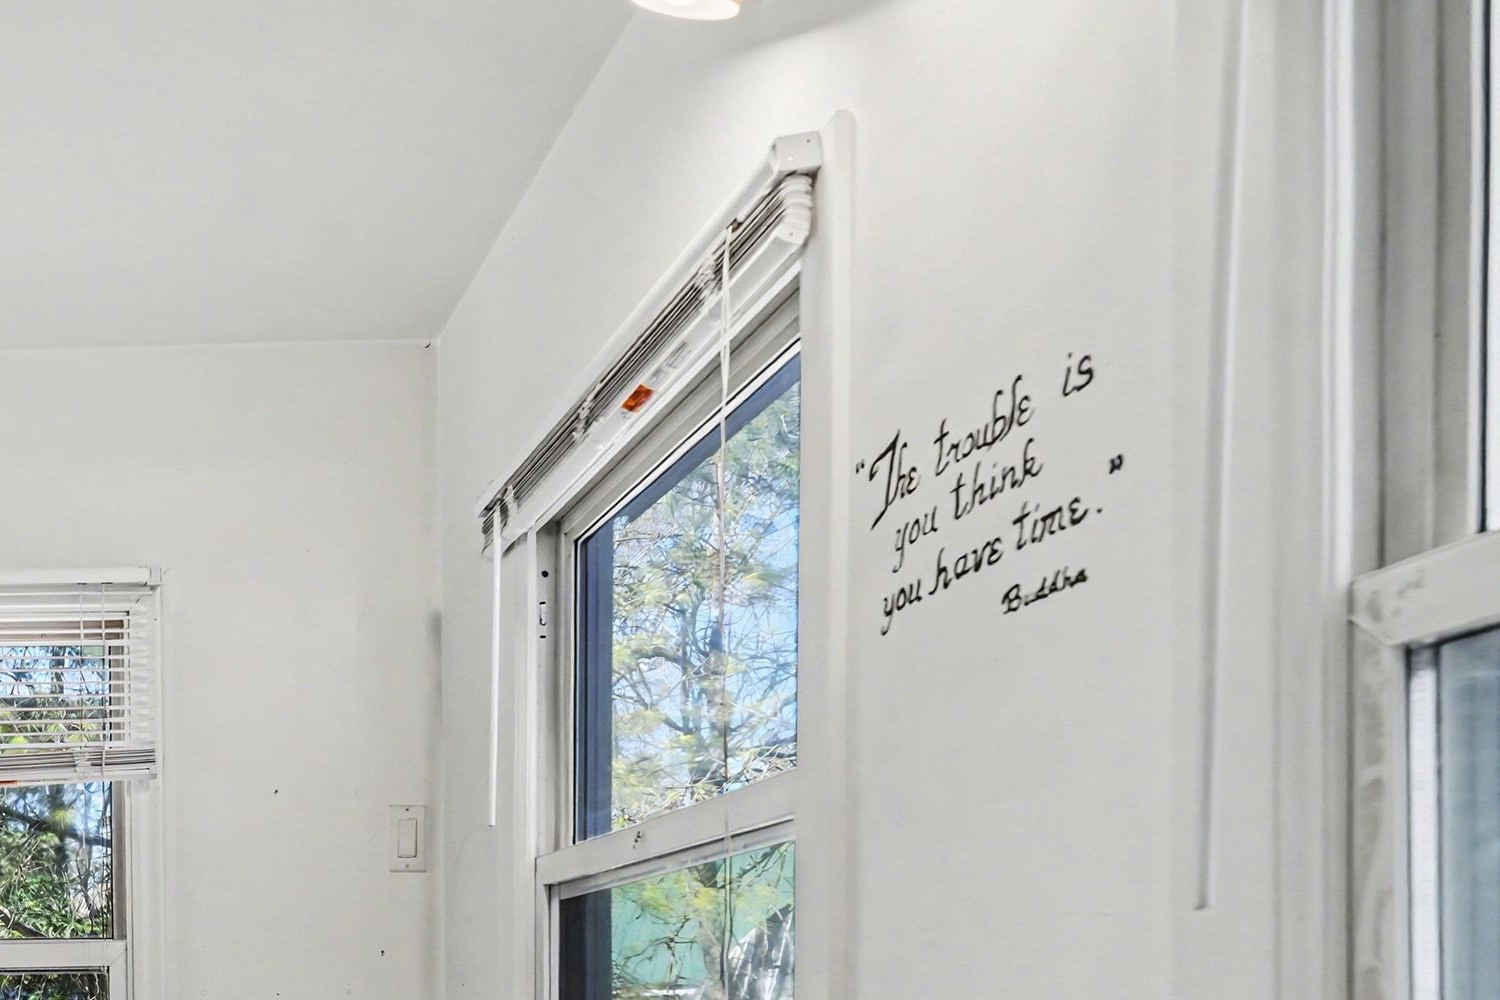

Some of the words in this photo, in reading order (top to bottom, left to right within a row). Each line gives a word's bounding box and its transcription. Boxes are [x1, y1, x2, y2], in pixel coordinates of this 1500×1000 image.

[856, 429, 918, 531] "The
[933, 374, 1033, 477] trouble
[1062, 353, 1094, 397] is
[892, 506, 938, 573] you
[950, 438, 1043, 520] think
[881, 579, 922, 636] you
[929, 537, 1004, 595] have
